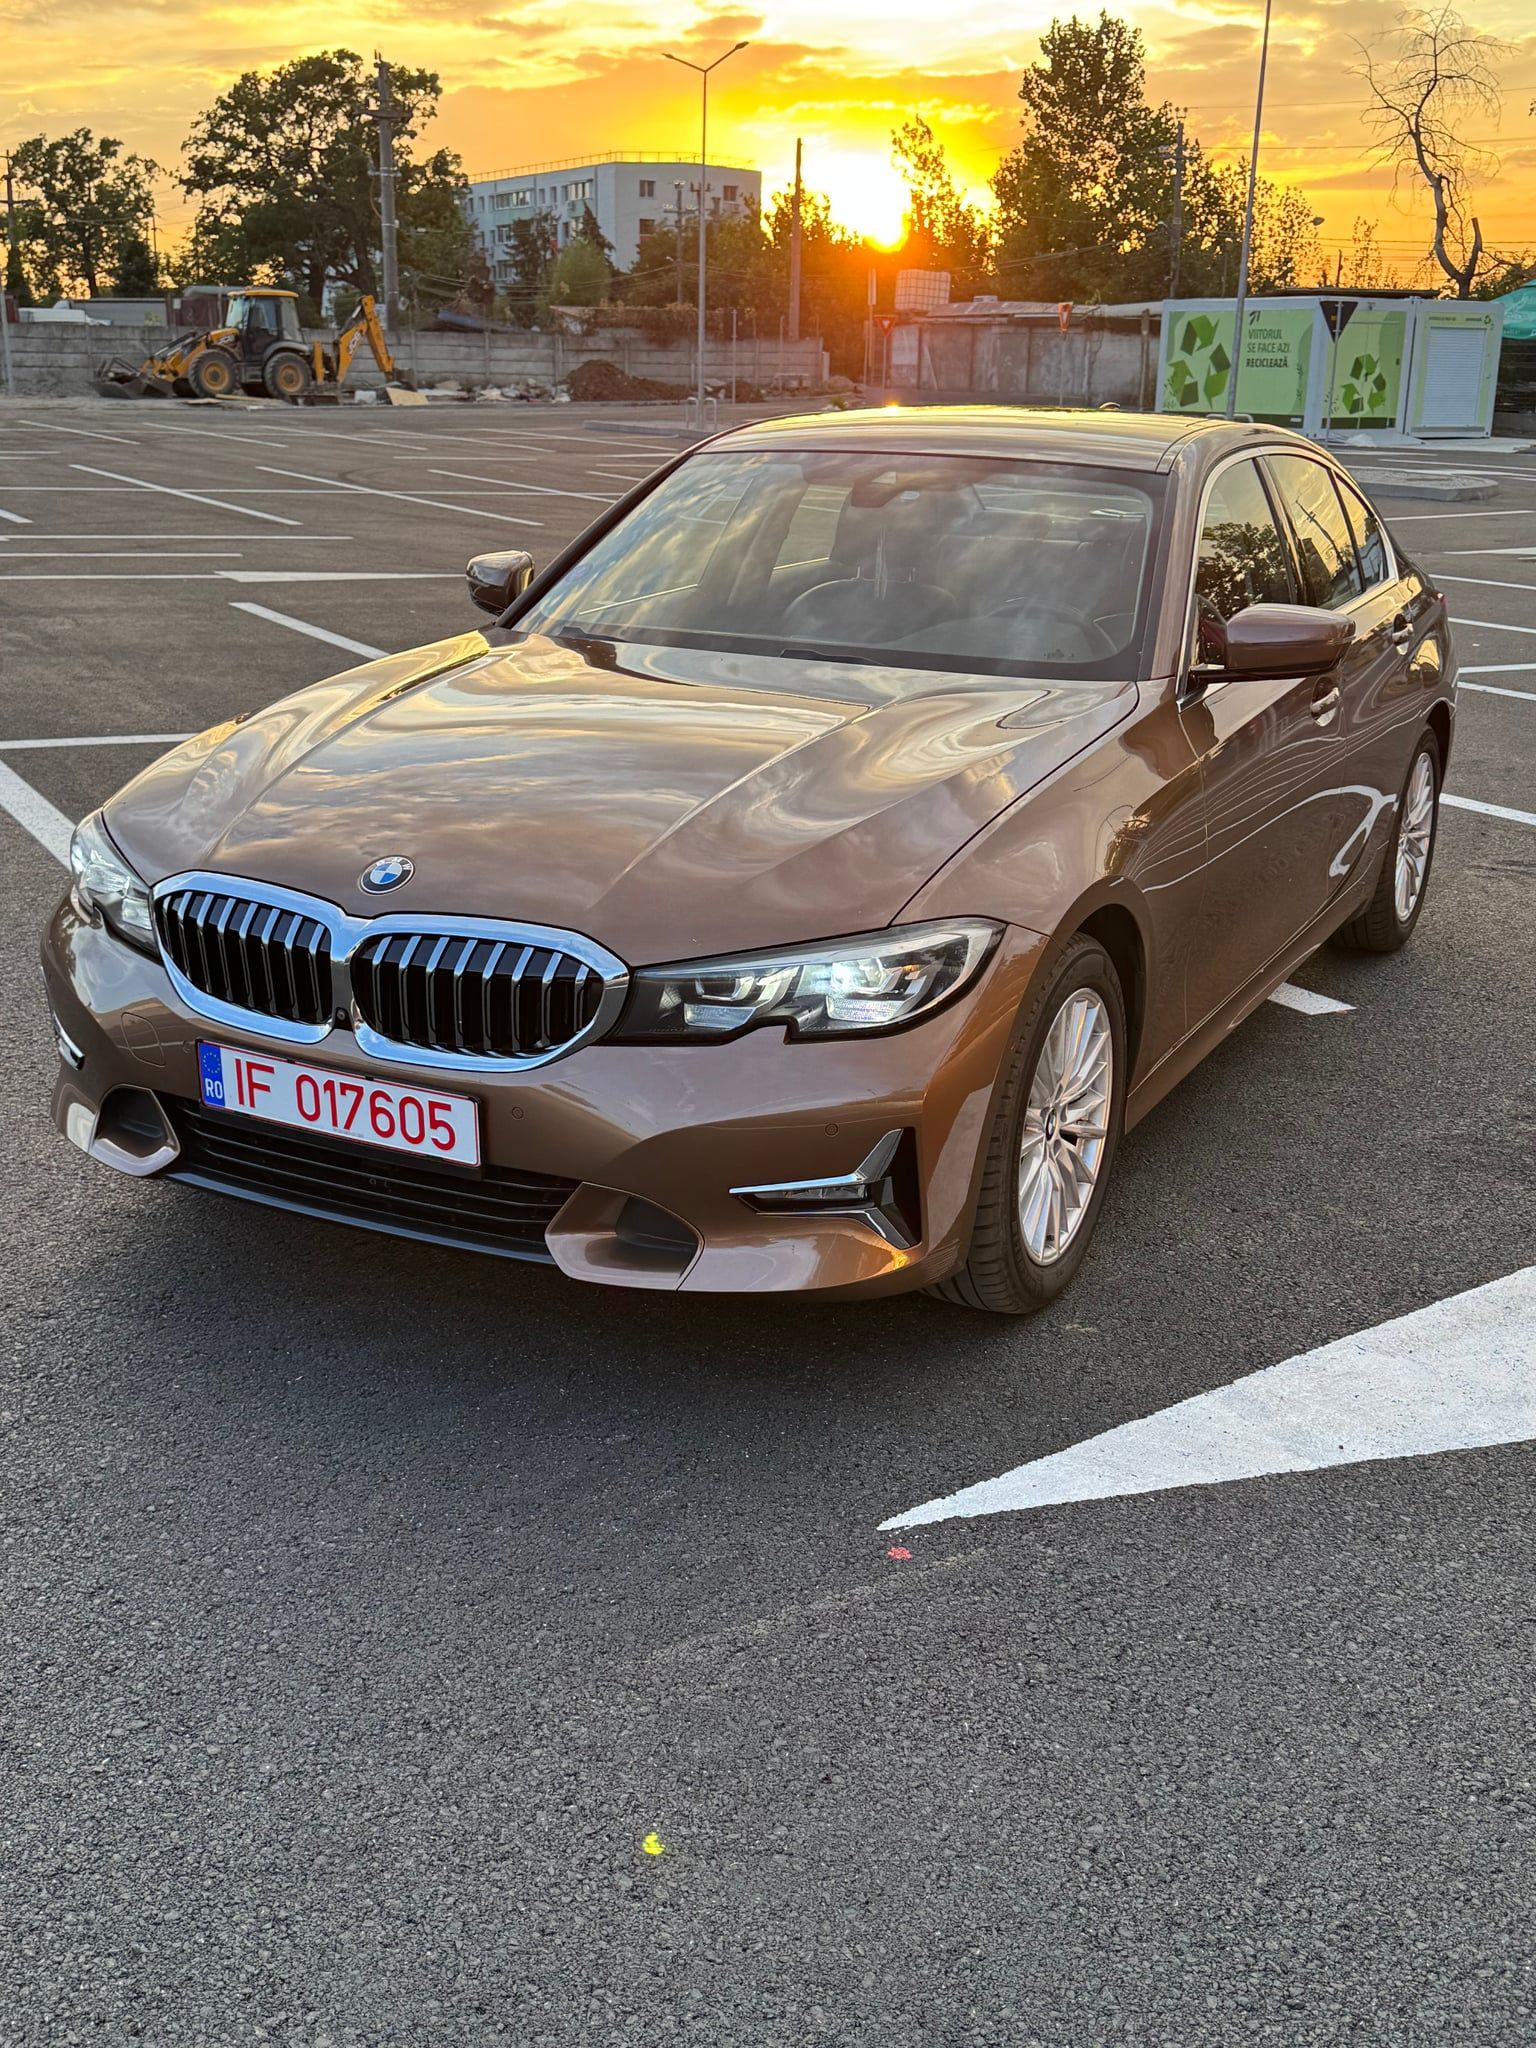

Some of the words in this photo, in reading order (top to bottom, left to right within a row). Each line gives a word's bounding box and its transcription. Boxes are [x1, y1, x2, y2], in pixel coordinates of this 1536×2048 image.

[1247, 342, 1256, 353] SE
[1257, 342, 1276, 353] FACE
[1277, 342, 1291, 353] AZI
[204, 1077, 223, 1100] RO
[235, 1058, 275, 1109] IF
[296, 1074, 456, 1151] 017605
